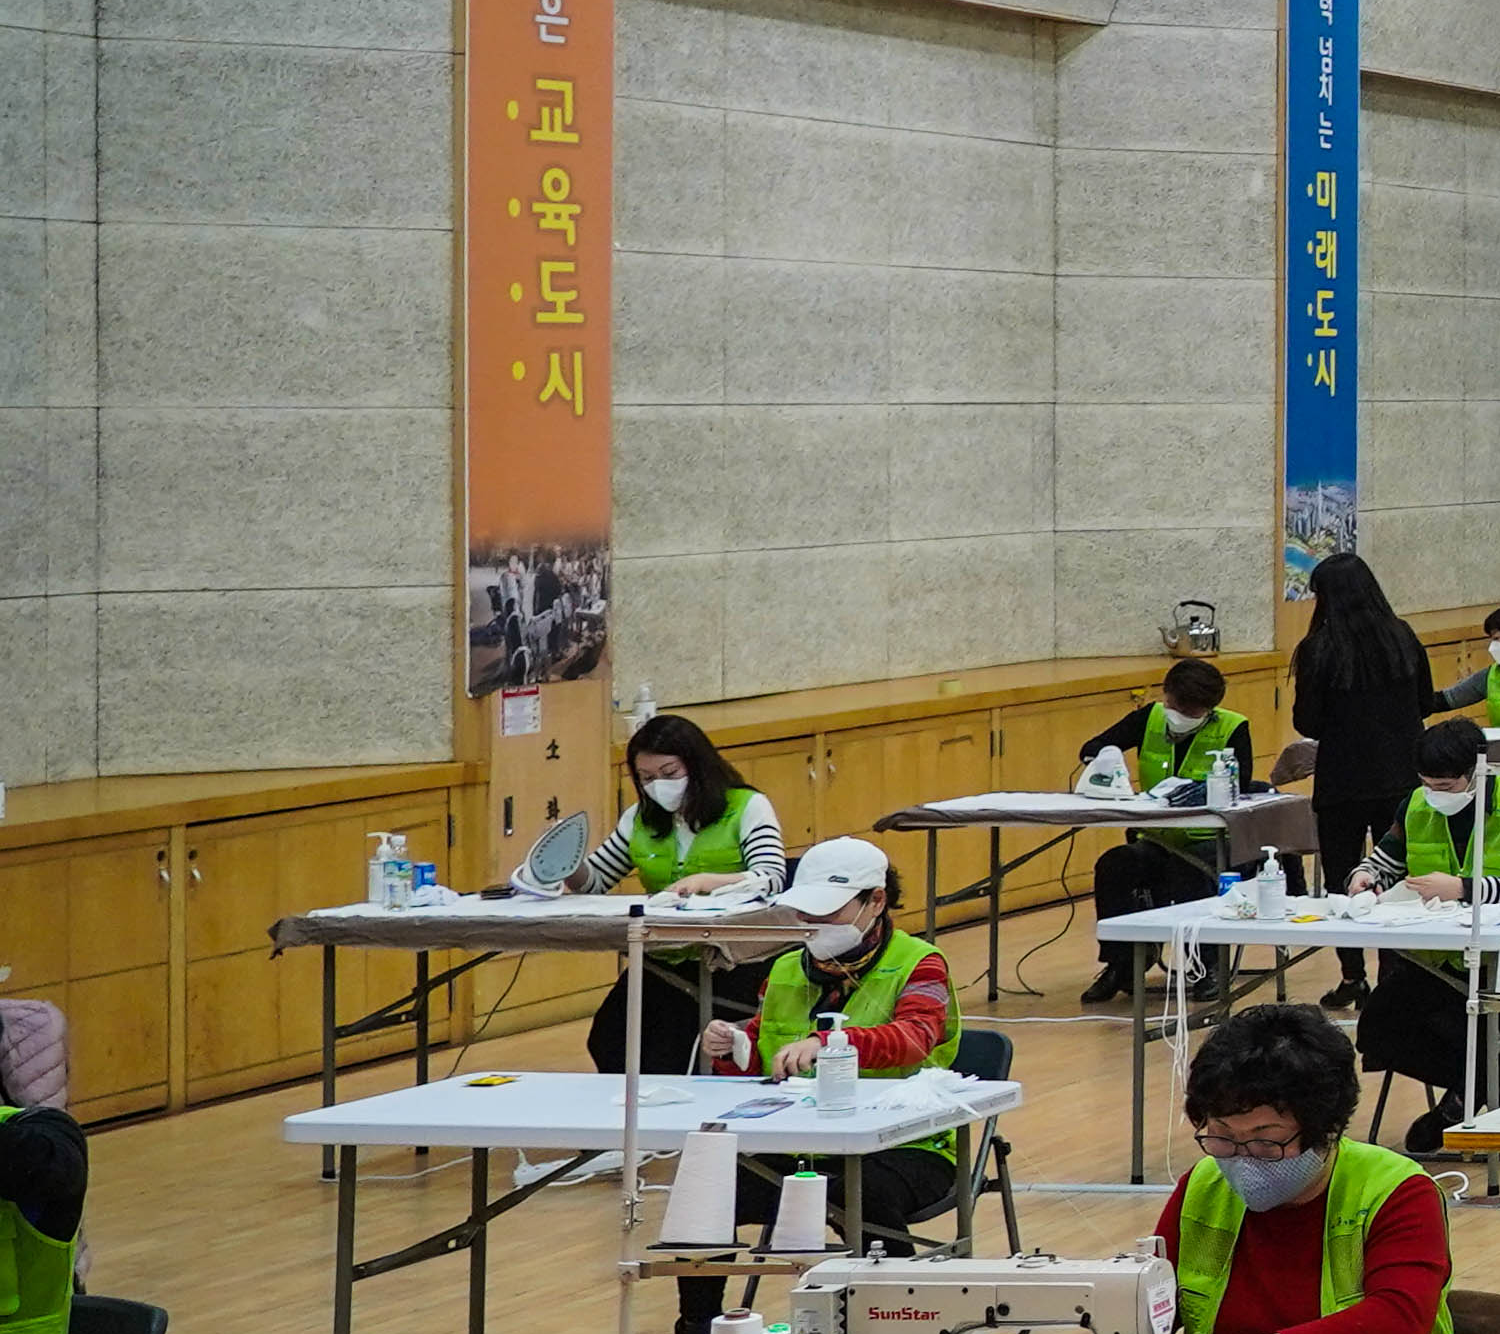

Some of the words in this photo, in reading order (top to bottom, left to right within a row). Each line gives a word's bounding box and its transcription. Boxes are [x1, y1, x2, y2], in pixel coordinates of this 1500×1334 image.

[1317, 37, 1333, 149] 넘치는
[530, 78, 584, 415] 교육도시
[1314, 170, 1337, 397] 미래도시
[868, 1306, 941, 1321] SunStar
